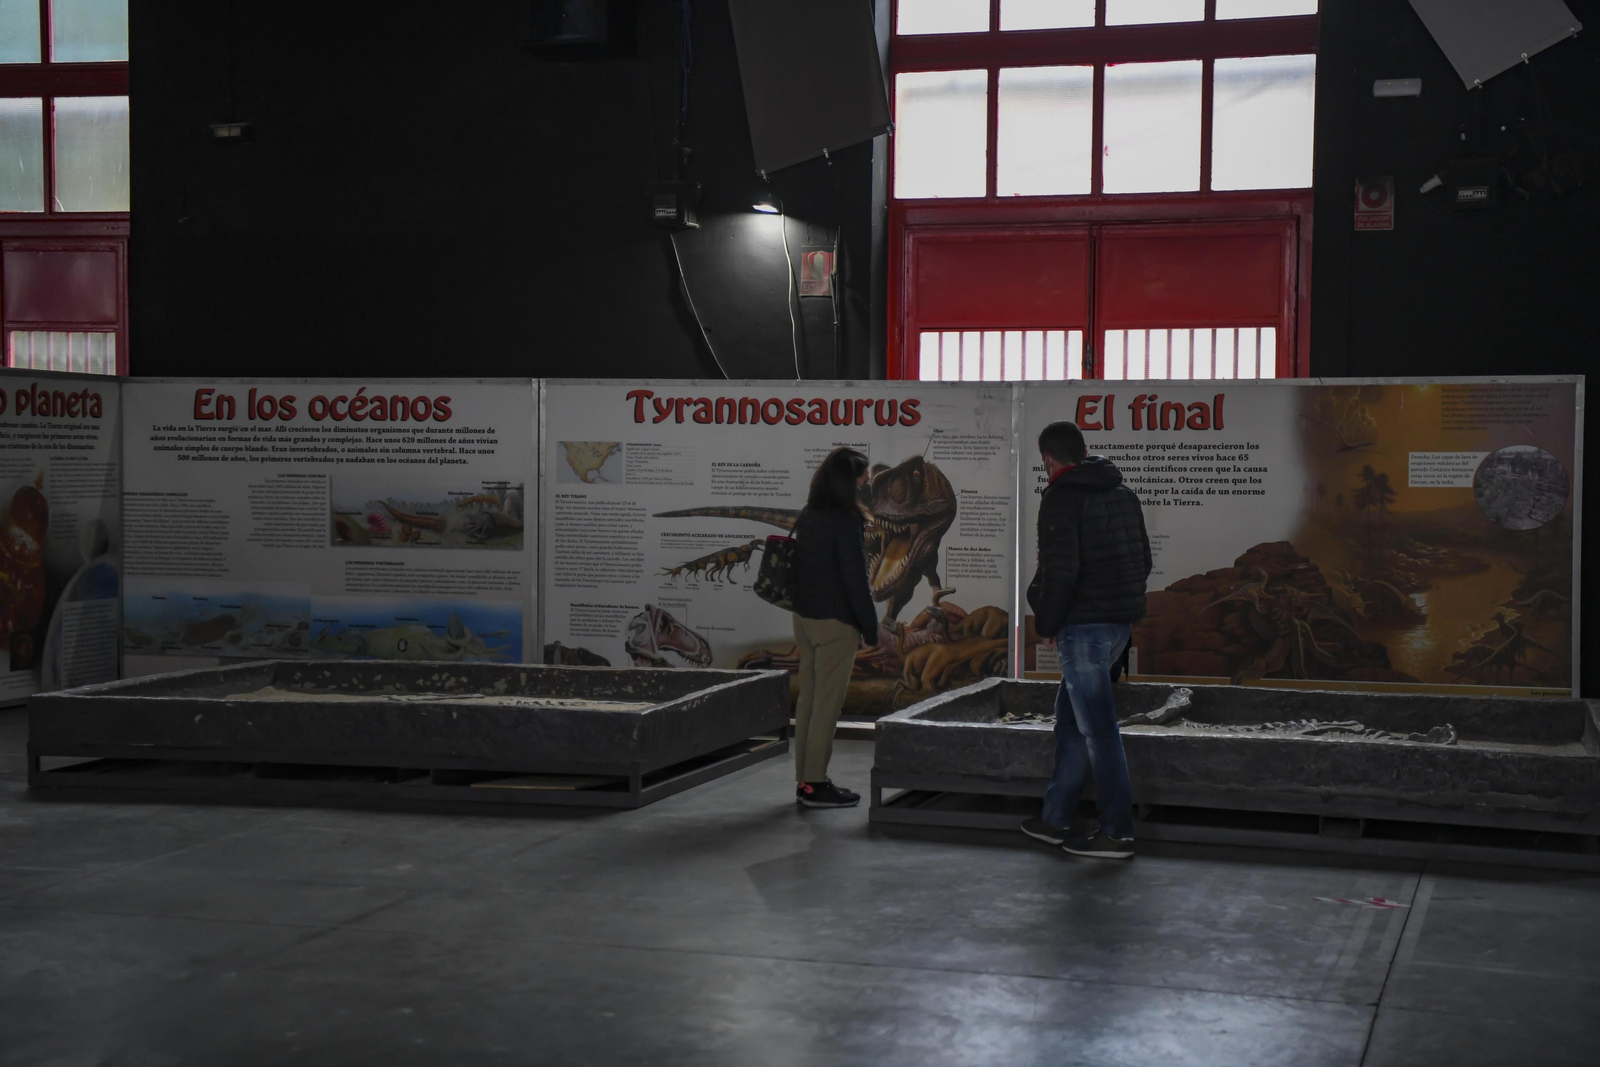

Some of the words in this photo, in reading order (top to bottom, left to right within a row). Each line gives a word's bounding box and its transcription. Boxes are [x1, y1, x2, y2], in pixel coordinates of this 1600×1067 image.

[16, 382, 102, 418] planeta
[193, 388, 236, 420] En
[248, 388, 297, 421] los
[308, 386, 452, 422] océanos
[626, 389, 921, 425] Tyrannosaurus
[1075, 394, 1116, 431] El
[1128, 394, 1225, 430] final
[370, 427, 410, 436] organismos
[293, 436, 320, 445] grandes
[328, 436, 364, 445] complejas.
[185, 445, 210, 454] simples
[289, 446, 339, 454] invertebrados,
[1146, 443, 1176, 451] porqué
[1178, 443, 1244, 451] desaparecieron
[230, 455, 247, 463] años,
[261, 456, 292, 464] primeros
[440, 457, 469, 466] planeta.
[1232, 478, 1247, 486] que
[1250, 476, 1262, 484] los
